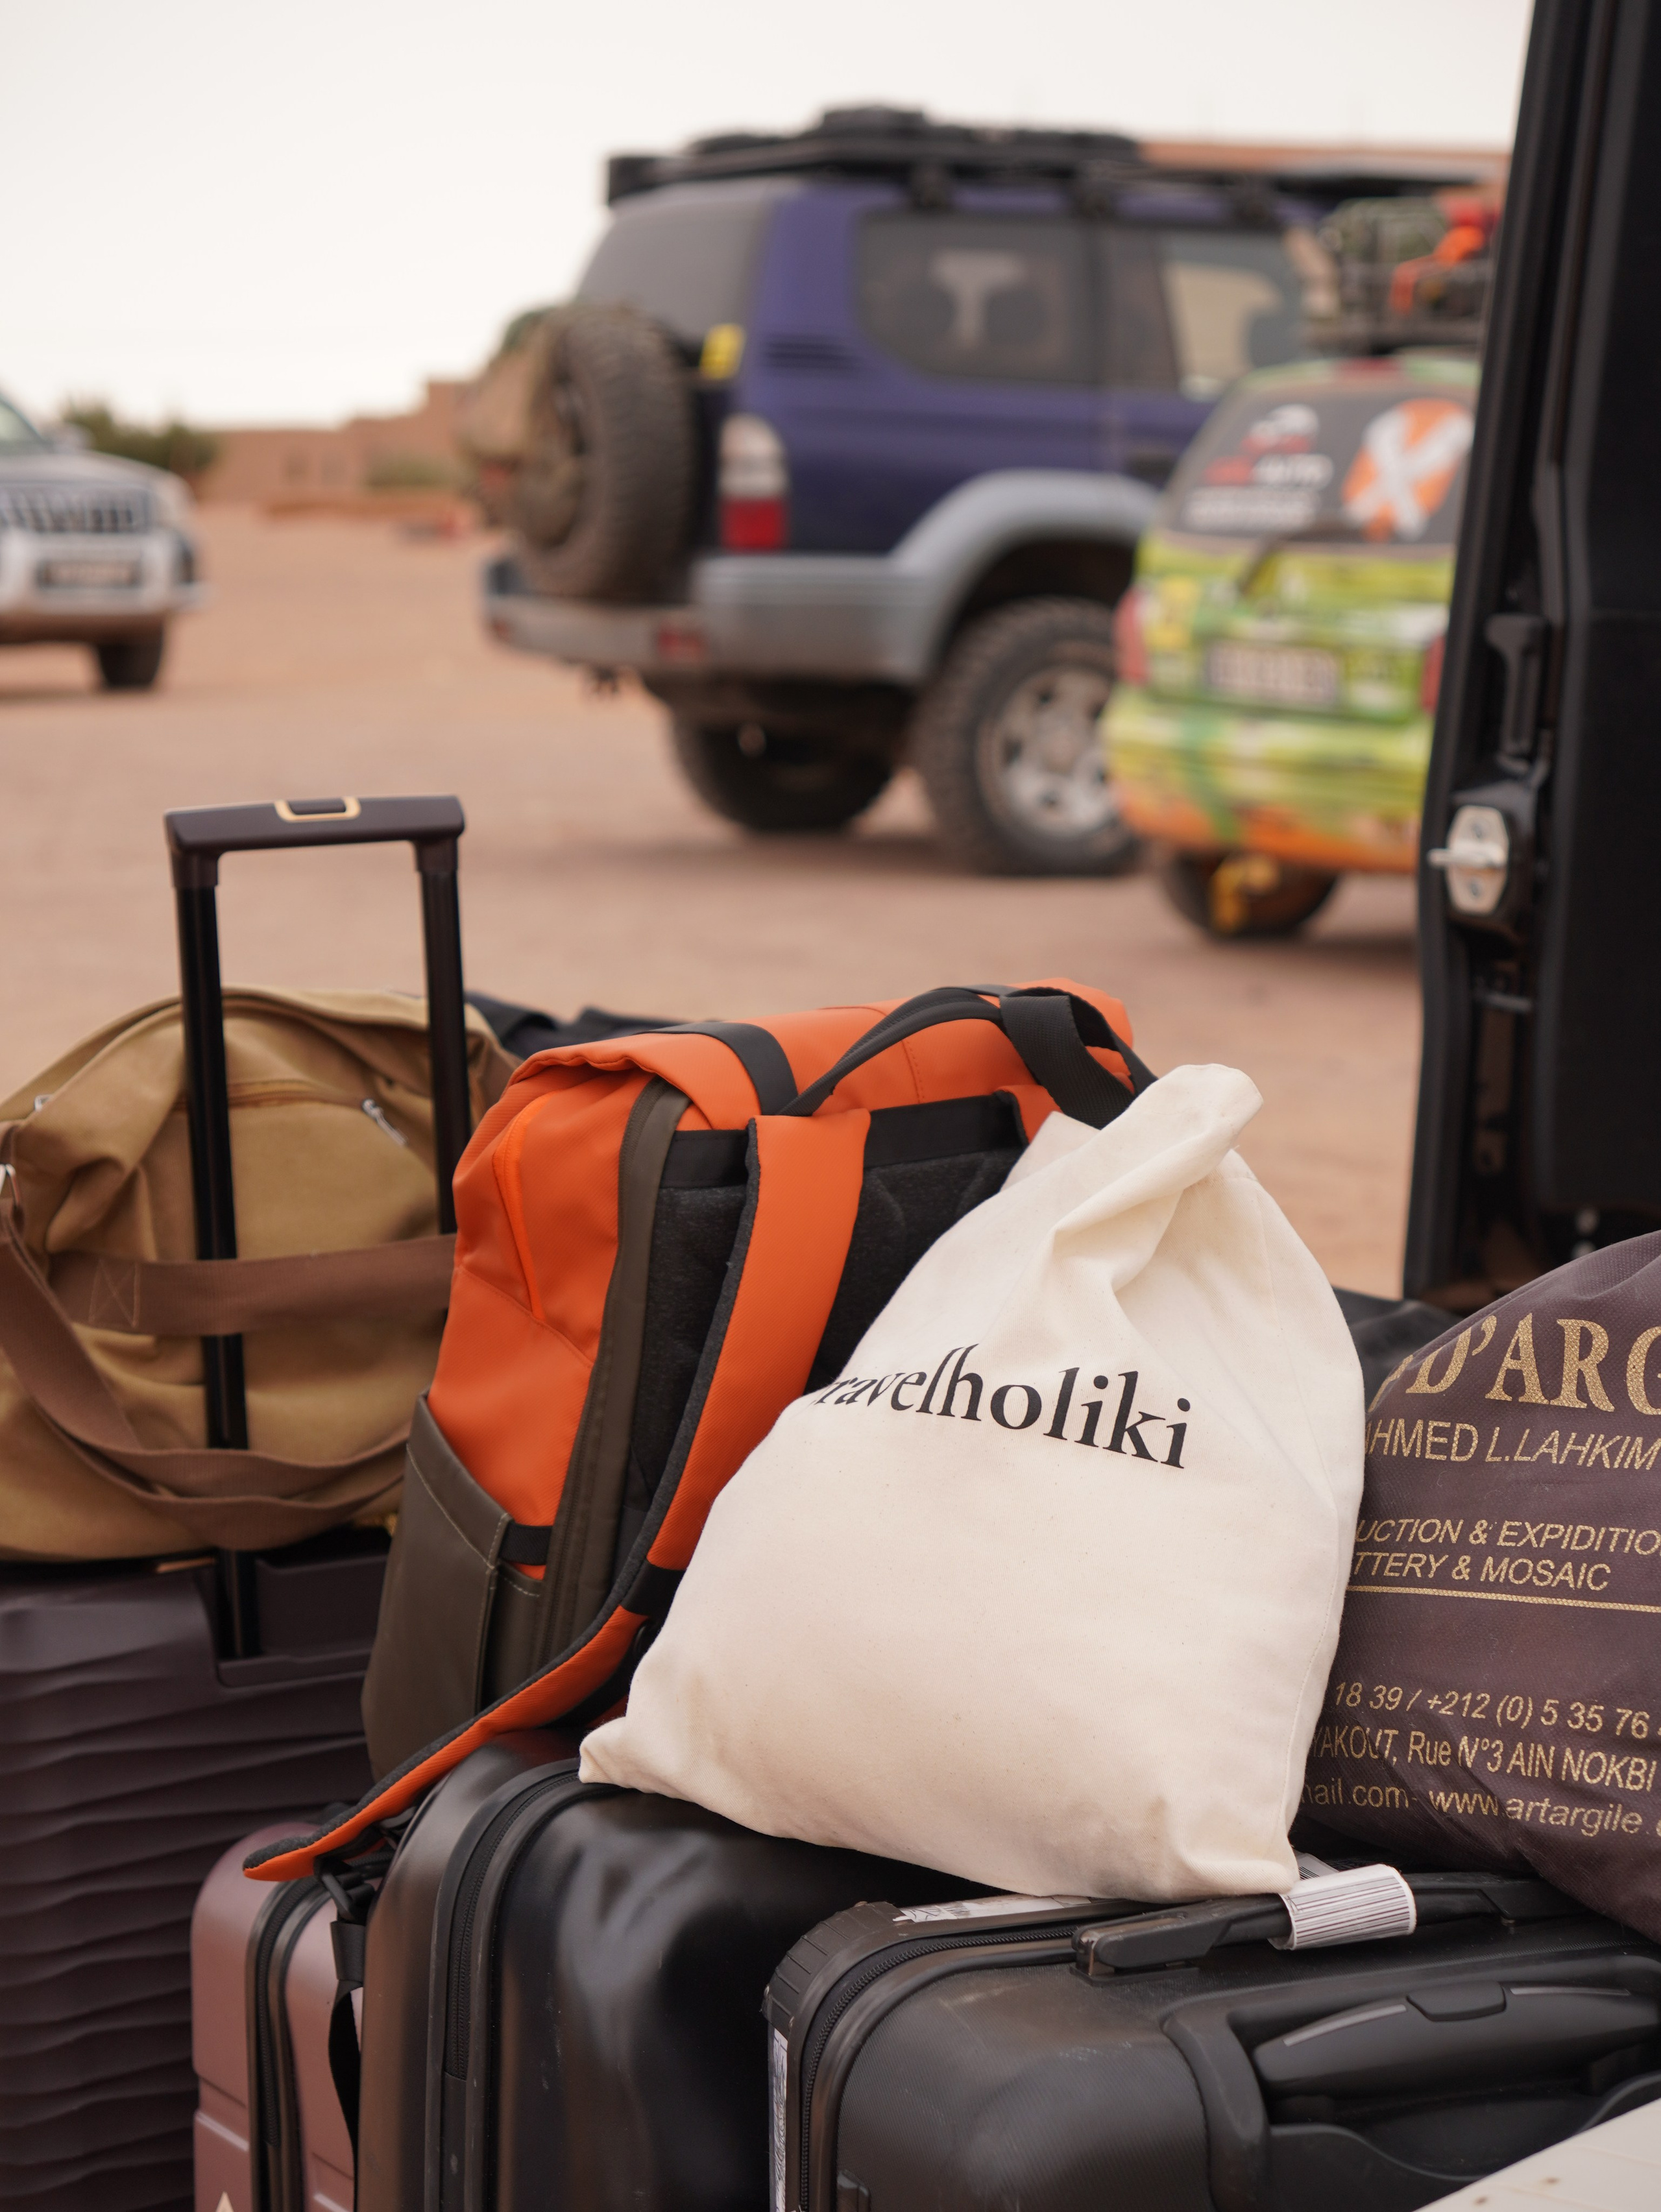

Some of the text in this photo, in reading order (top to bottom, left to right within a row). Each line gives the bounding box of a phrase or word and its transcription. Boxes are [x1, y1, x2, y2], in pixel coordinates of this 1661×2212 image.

[811, 1343, 1191, 1469] ravelholiki
[1468, 1519, 1488, 1545] &
[1497, 1520, 1661, 1556] EXPIDITIO
[1353, 1551, 1612, 1591] TTERY & MOSAIC
[1335, 1681, 1363, 1707] 18
[1427, 1690, 1491, 1720] +212
[1496, 1694, 1534, 1729] (0)
[1540, 1699, 1559, 1725] 5
[1566, 1701, 1605, 1733] 35
[1616, 1708, 1651, 1740] 76
[1407, 1731, 1452, 1766] Rue
[1506, 1742, 1556, 1779] AIN
[1561, 1747, 1658, 1792] NOKBI
